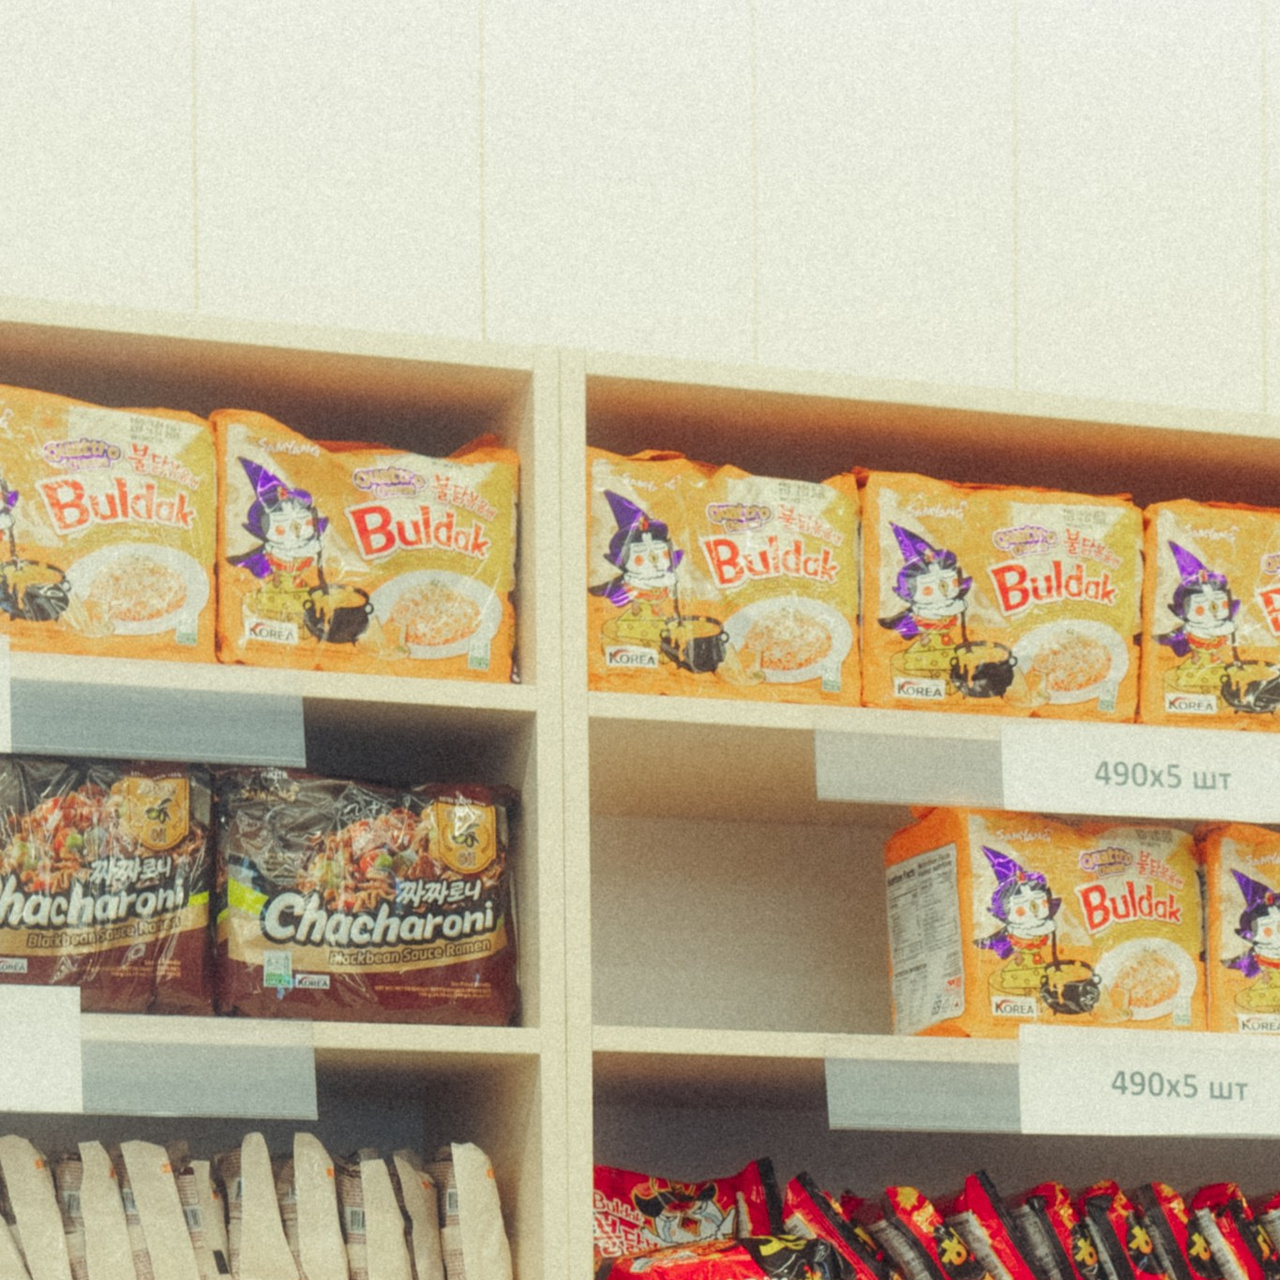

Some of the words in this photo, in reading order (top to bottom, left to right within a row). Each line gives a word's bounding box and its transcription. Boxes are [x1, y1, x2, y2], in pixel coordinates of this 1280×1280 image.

[41, 477, 195, 530] Buldak
[350, 504, 491, 558] Buldak
[704, 535, 839, 585] Buldak
[990, 560, 1116, 613] Buldak
[249, 621, 295, 641] KOREA
[609, 649, 656, 666] KOREA
[897, 681, 942, 697] KOREA
[1168, 697, 1214, 712] KOREA
[1193, 772, 1232, 790] шт
[396, 879, 482, 906] 짜짜로니
[1079, 881, 1182, 931] Buldak
[264, 892, 494, 945] Chacharoni
[401, 946, 445, 963] Sauce
[296, 976, 329, 988] KOREA
[994, 1000, 1035, 1014] KOREA
[1209, 1083, 1249, 1101] шт
